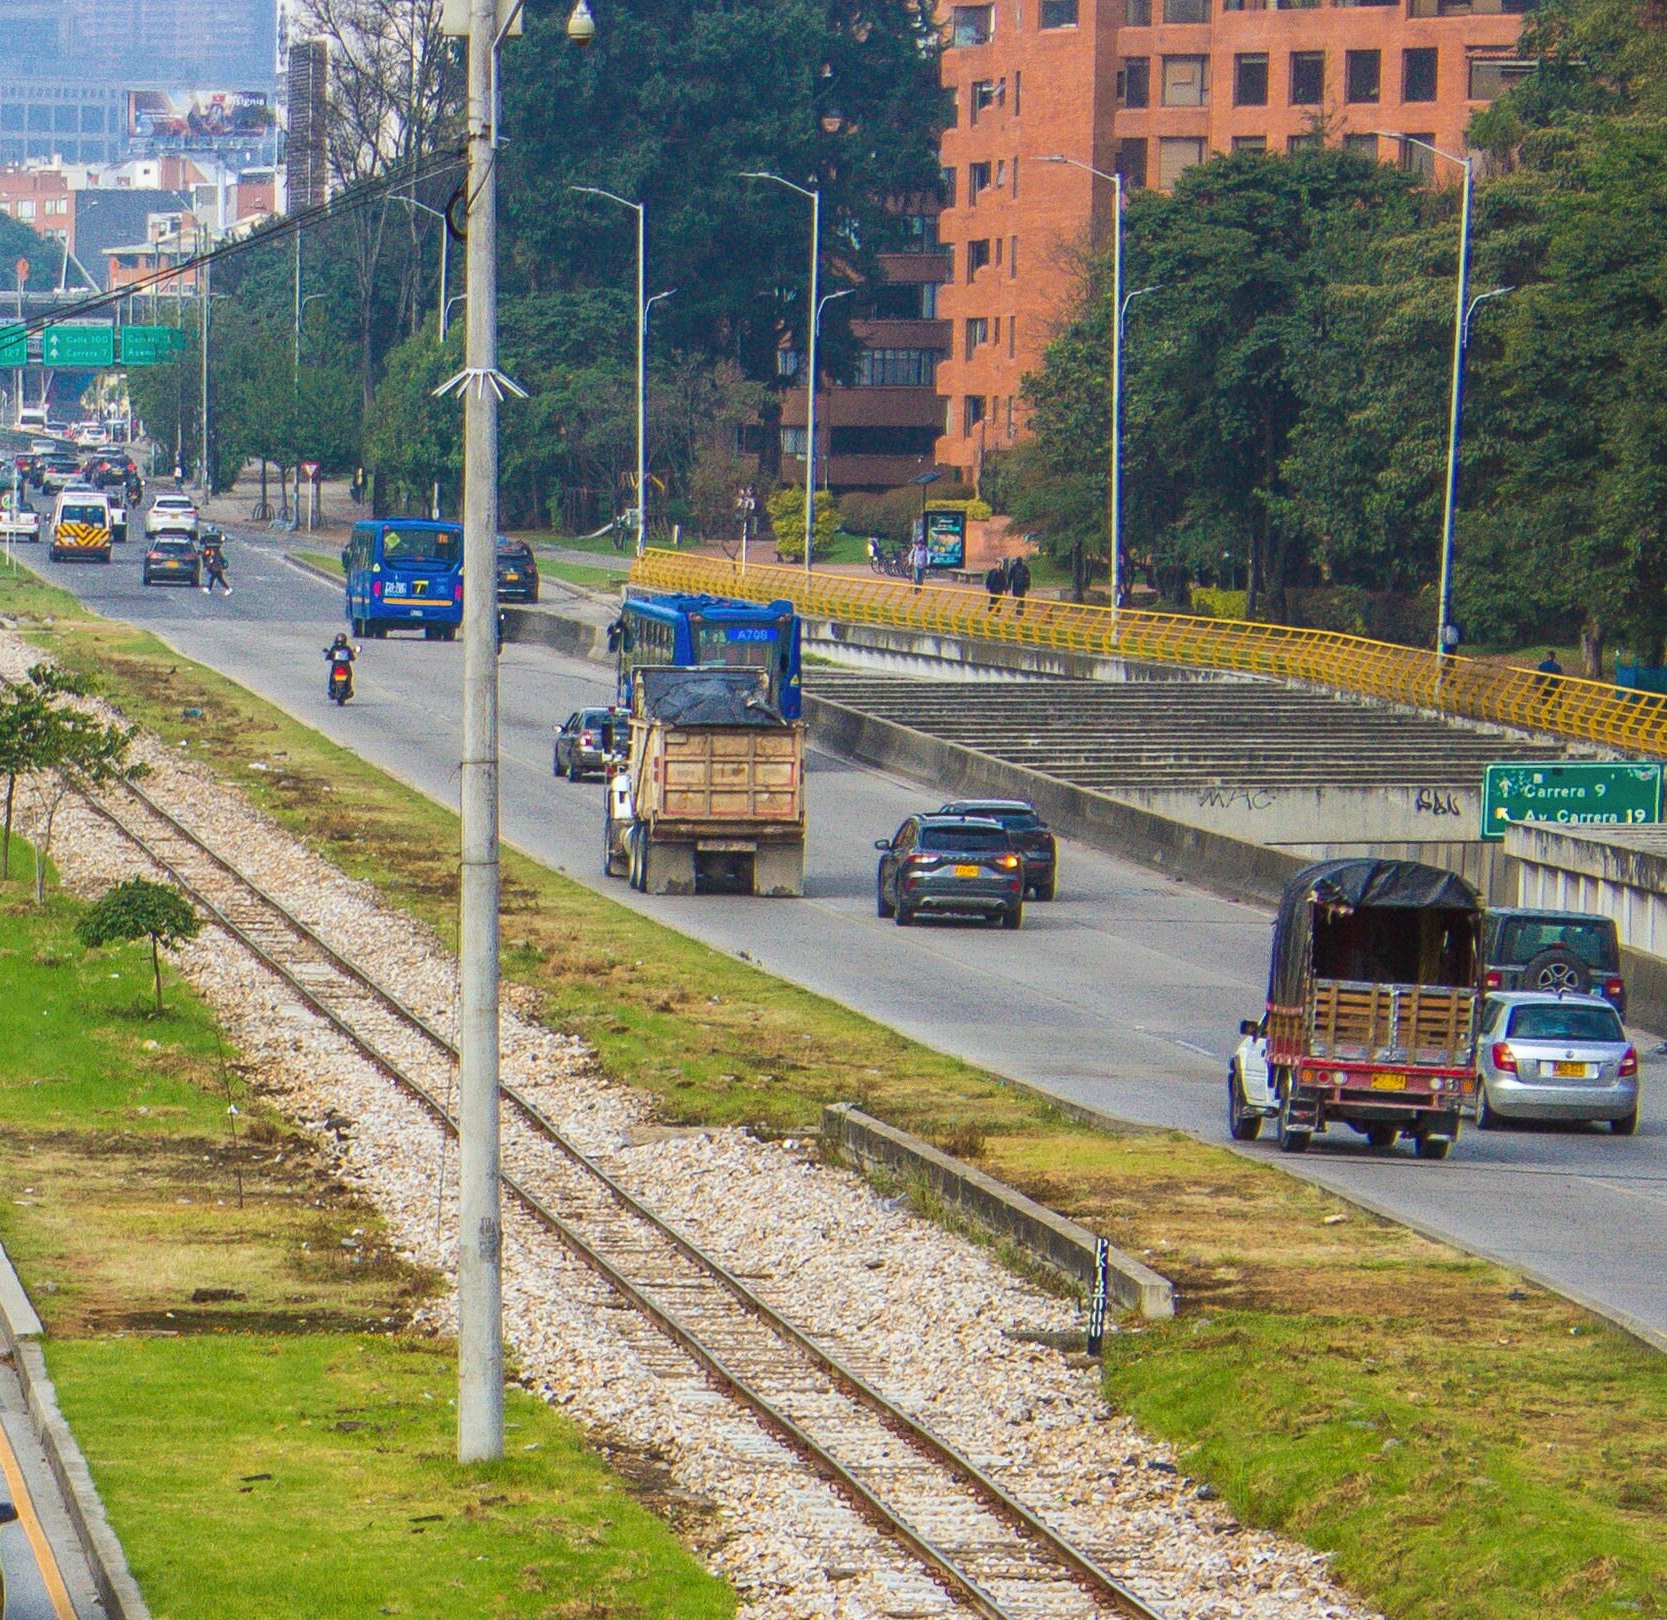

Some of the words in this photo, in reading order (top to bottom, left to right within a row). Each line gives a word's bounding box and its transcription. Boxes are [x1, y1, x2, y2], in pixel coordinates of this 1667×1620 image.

[1524, 784, 1586, 798] Carrera
[1594, 783, 1607, 798] 9
[1524, 808, 1548, 821] Av
[1556, 809, 1618, 824] Carrera
[1626, 808, 1647, 824] 19
